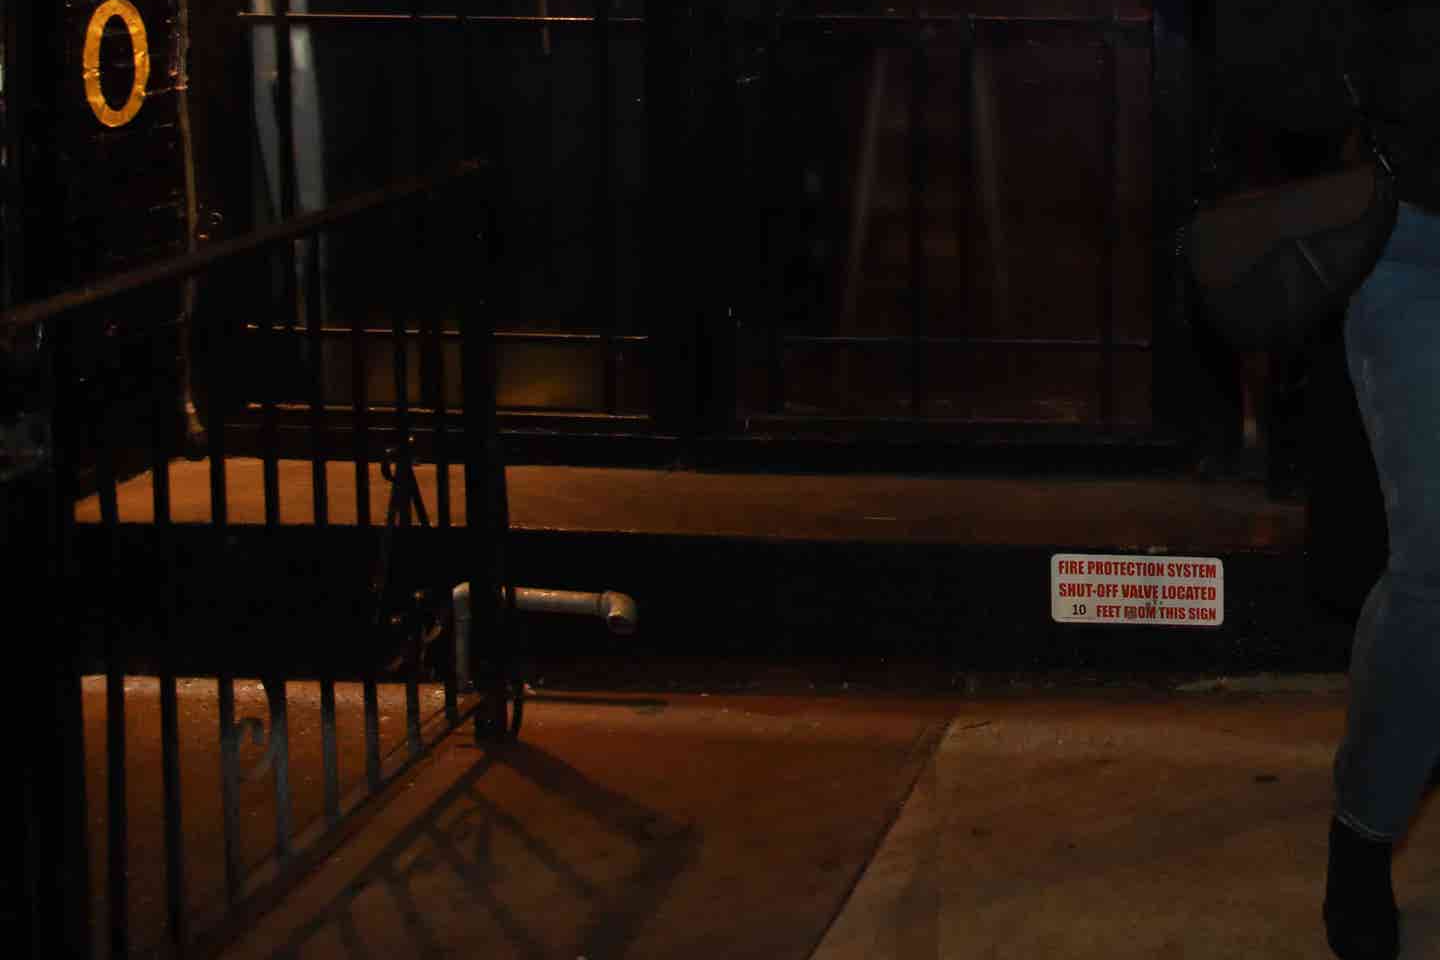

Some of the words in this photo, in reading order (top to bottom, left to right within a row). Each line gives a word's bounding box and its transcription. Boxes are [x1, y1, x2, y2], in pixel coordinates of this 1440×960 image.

[1058, 560, 1084, 575] FIRE
[1087, 561, 1165, 577] PROTECTION
[1167, 563, 1217, 578] SYSTEM
[1058, 582, 1119, 598] SHUT-OFF
[1121, 584, 1159, 600] VALVE
[1161, 585, 1217, 601] LOCATED
[1071, 604, 1087, 616] 10
[1096, 605, 1122, 618] FEET
[1158, 606, 1186, 620] THIS
[1188, 607, 1217, 621] SIGN
